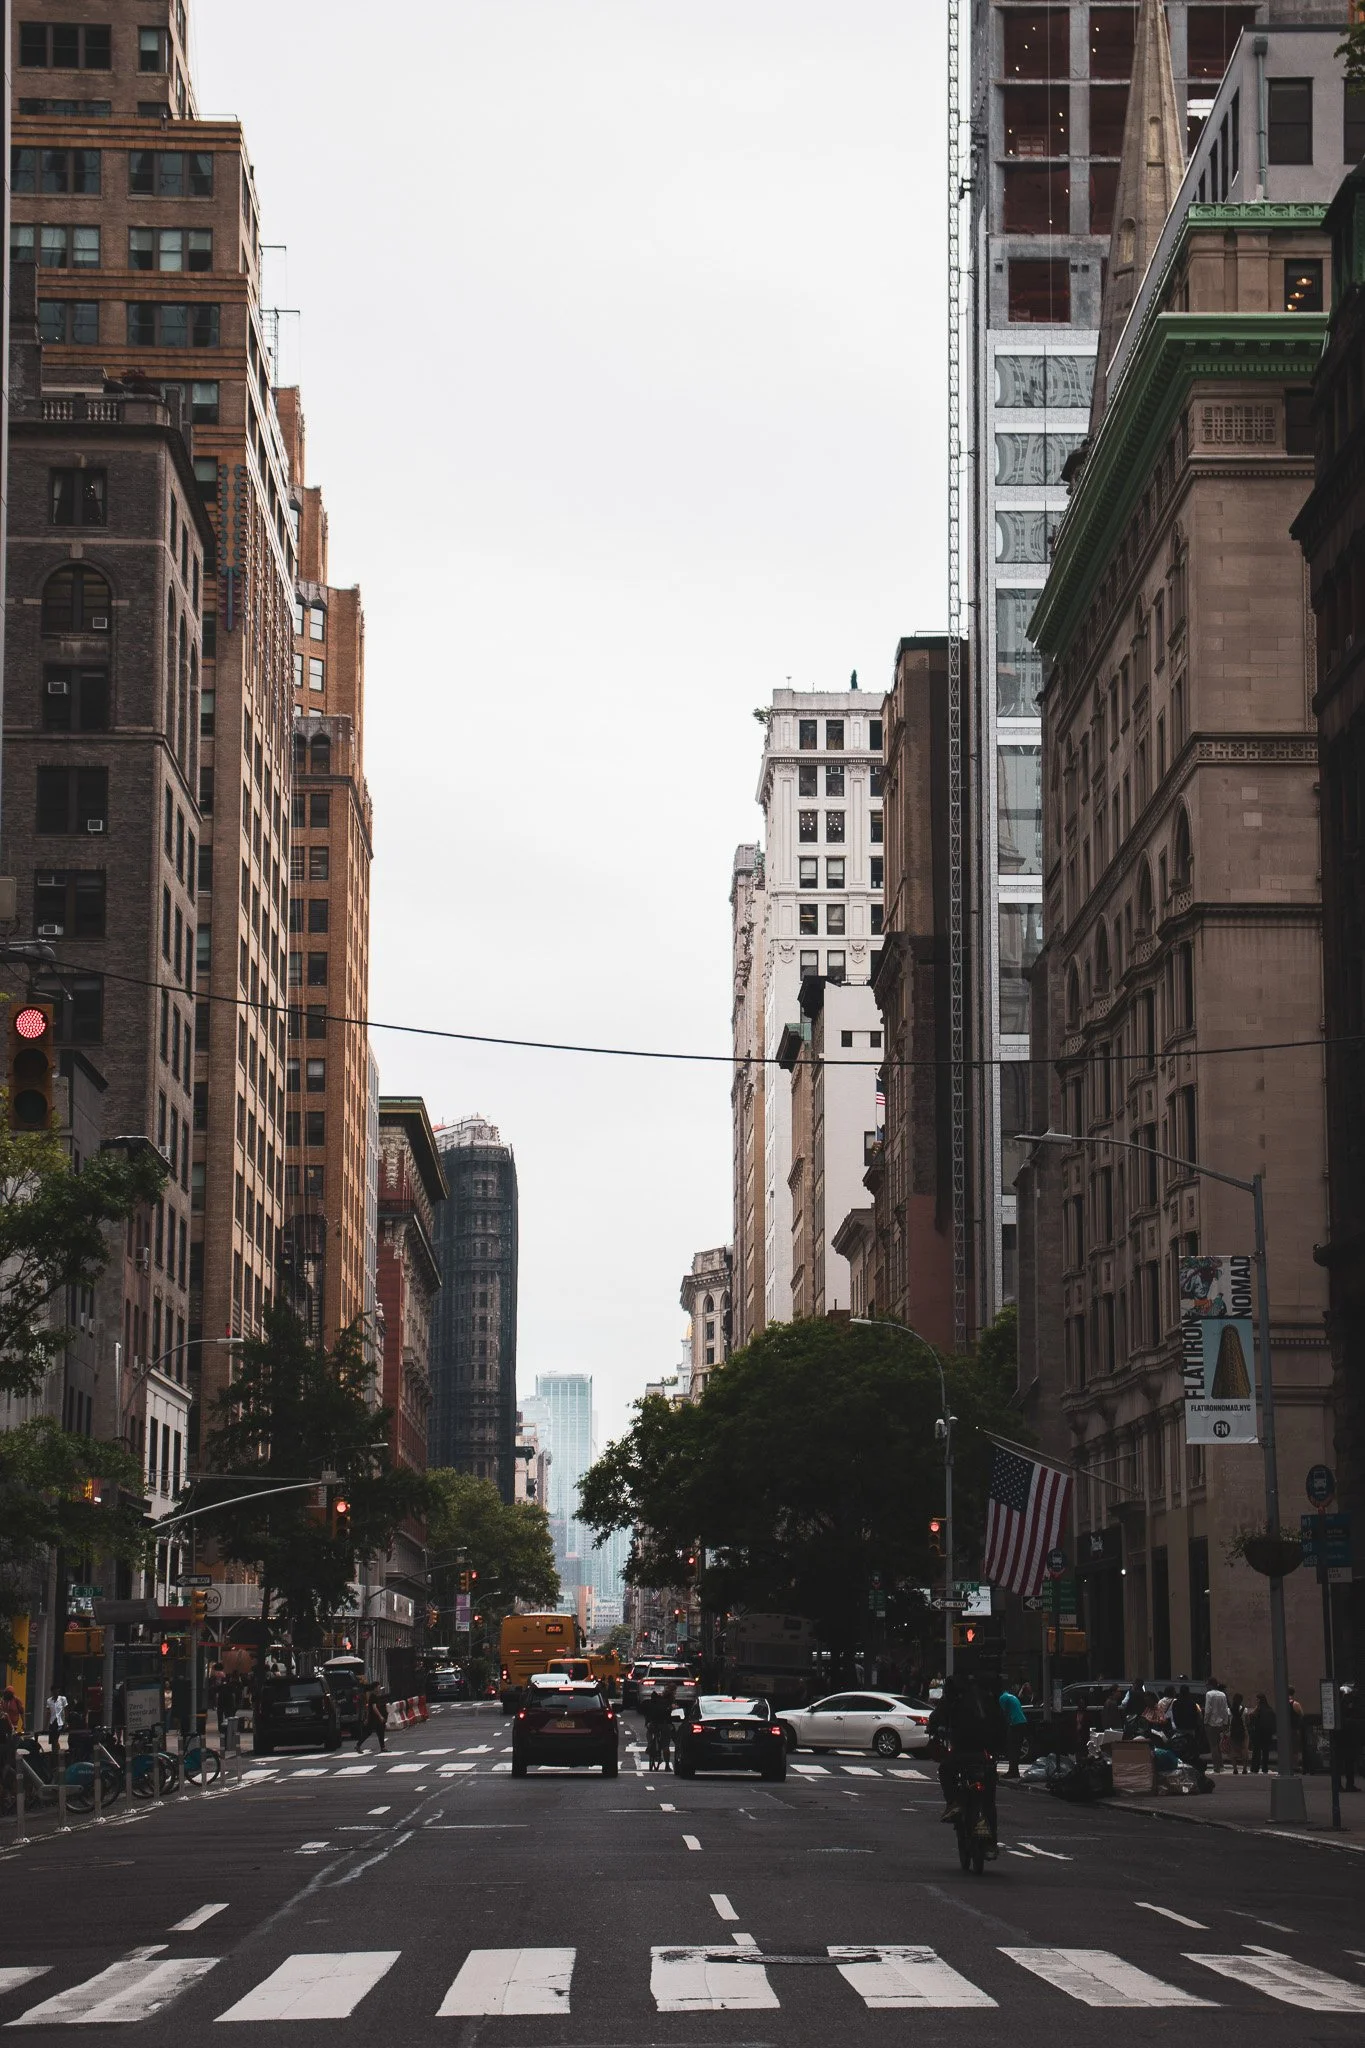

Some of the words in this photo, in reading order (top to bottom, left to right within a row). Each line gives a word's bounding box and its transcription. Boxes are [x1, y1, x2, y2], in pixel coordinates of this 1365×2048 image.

[1230, 1256, 1252, 1319] NOMAD
[1182, 1314, 1205, 1400] FLATIRON
[1190, 1404, 1251, 1412] FLATIRONNOMAD.NYC
[75, 1588, 80, 1596] E
[83, 1588, 94, 1596] 30
